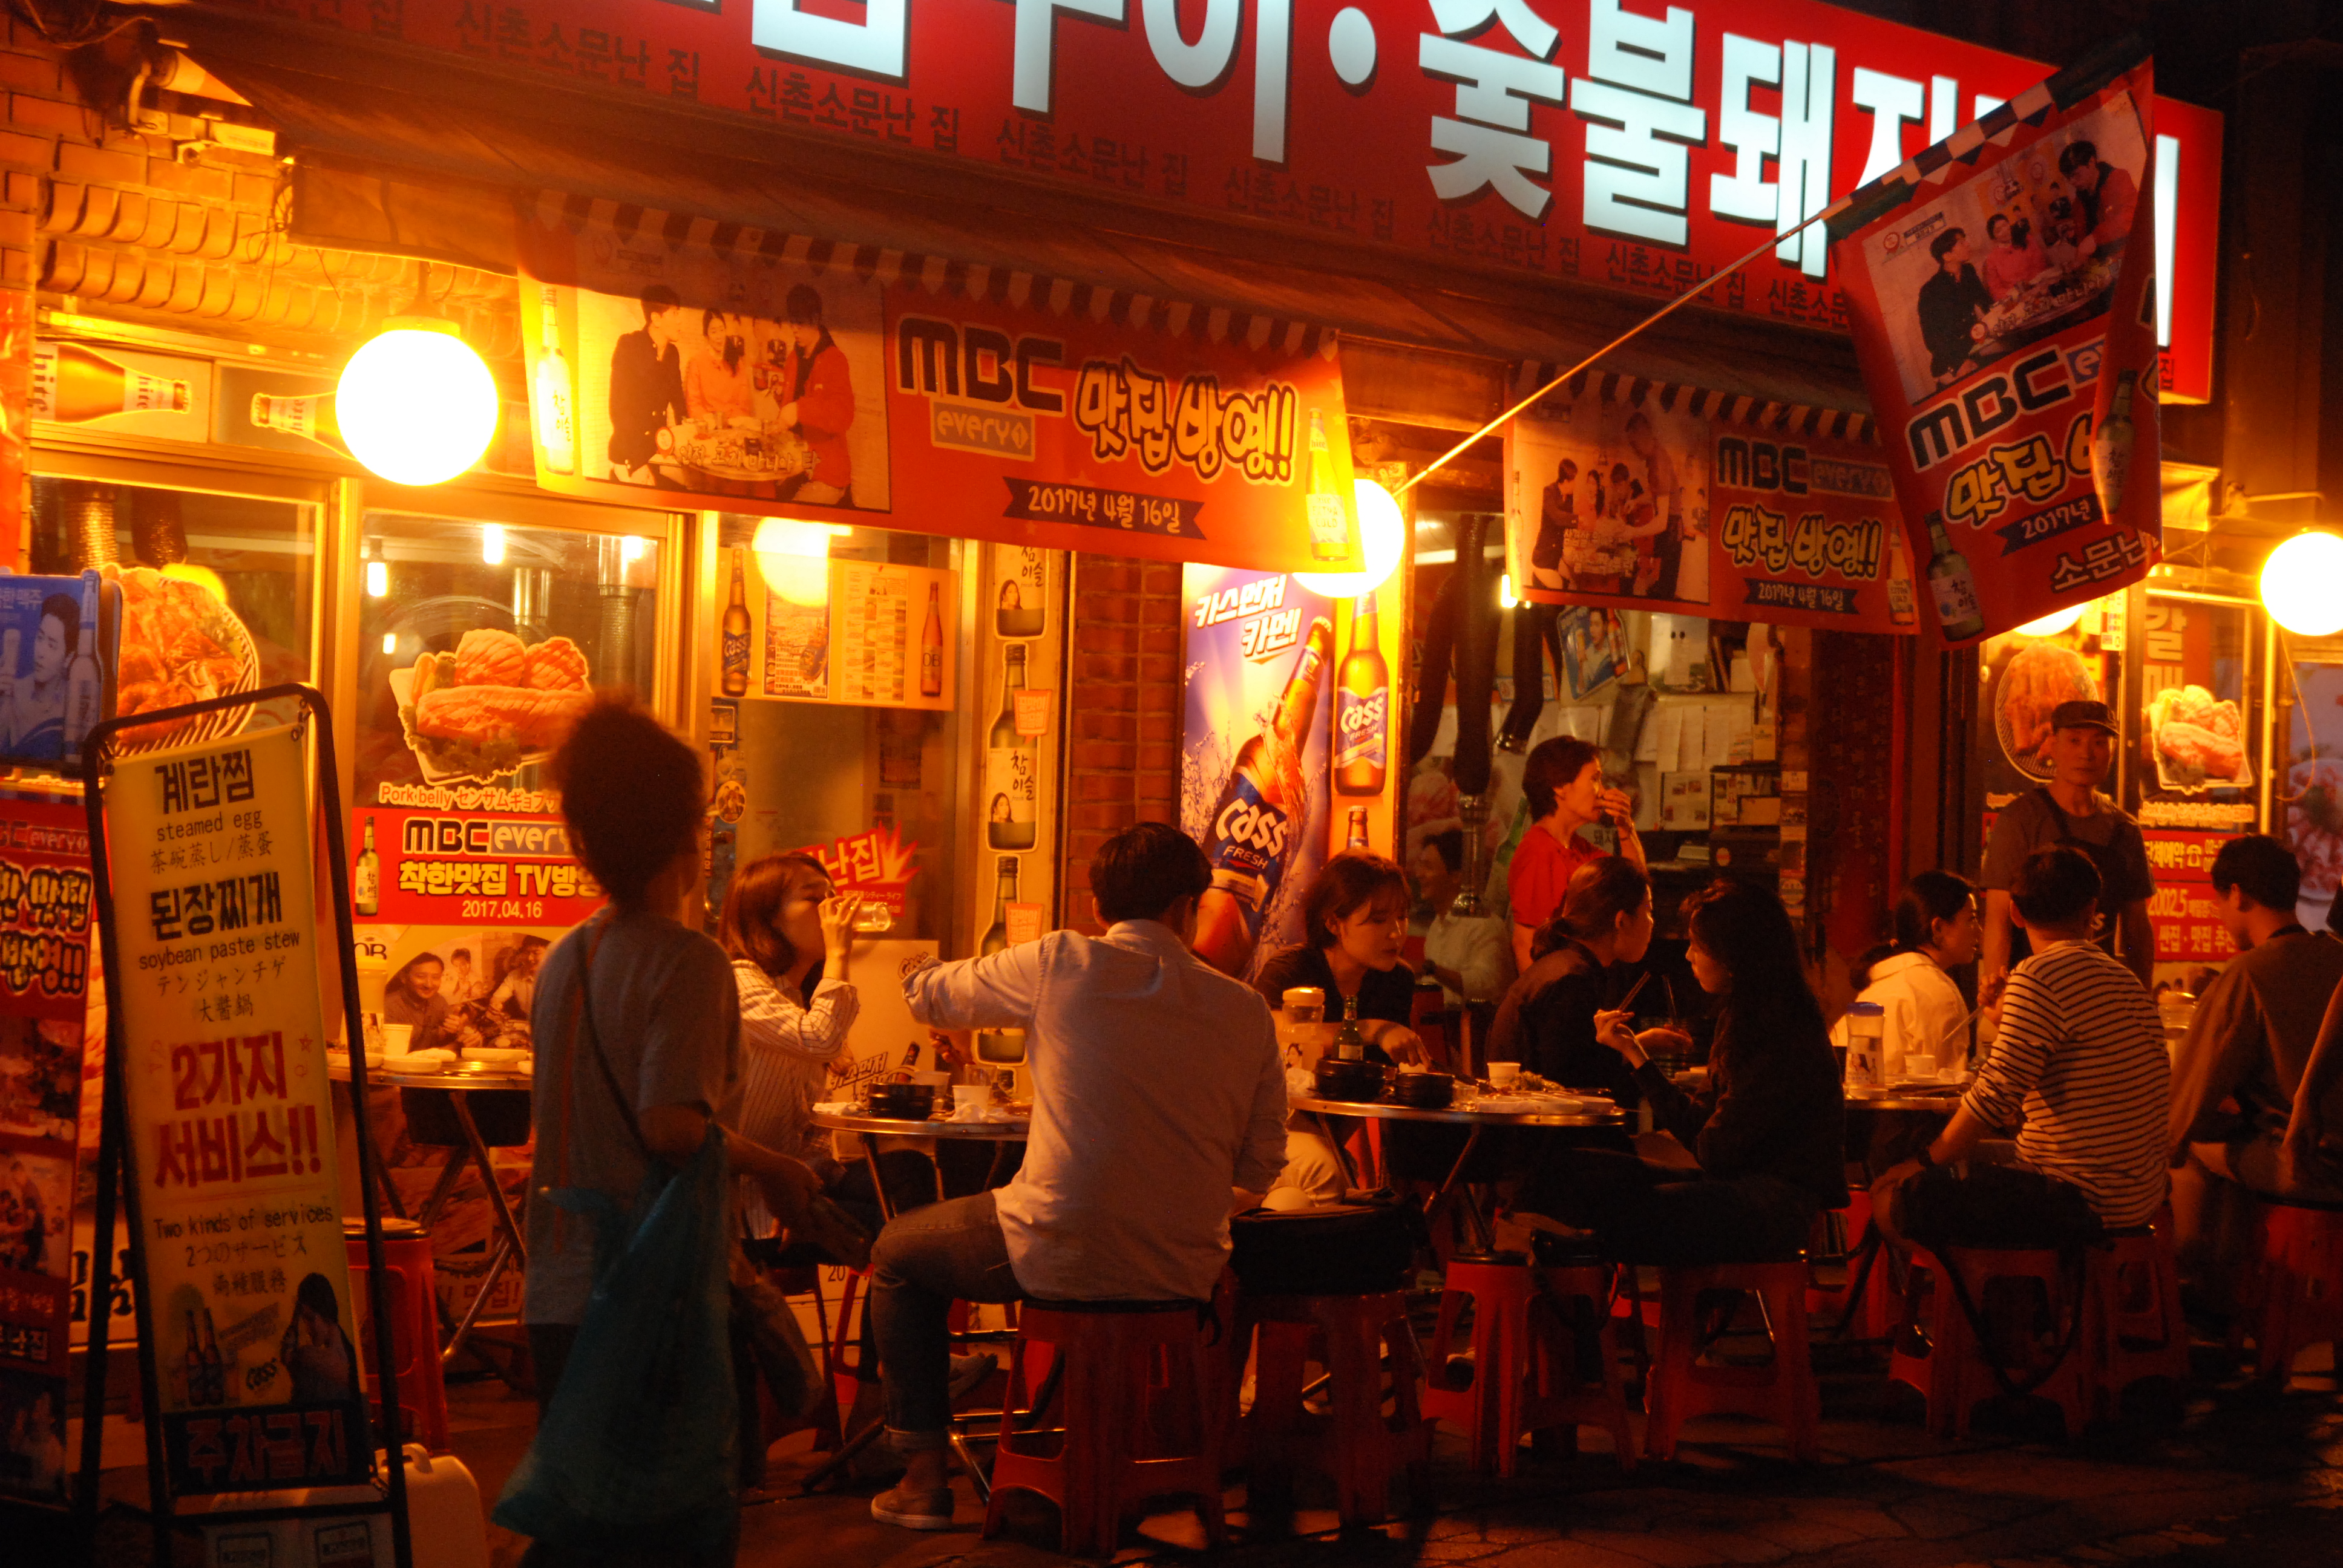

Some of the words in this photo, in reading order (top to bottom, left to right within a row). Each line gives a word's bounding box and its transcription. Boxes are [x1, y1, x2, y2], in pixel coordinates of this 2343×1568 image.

[454, 0, 650, 89] 신촌소문난
[666, 48, 700, 100] 집
[745, 67, 916, 143] 신촌소문난
[931, 106, 958, 152] 집
[997, 119, 1149, 189] 신촌소문난
[1162, 153, 1187, 196] 집
[1225, 166, 1361, 234] 신촌소문난
[1371, 199, 1394, 241] 집
[1426, 208, 1548, 270] 신촌소문난
[1559, 237, 1579, 275] 집
[1726, 270, 1746, 309] 집
[899, 318, 1063, 414] MBC
[137, 376, 151, 410] hite
[1909, 348, 2073, 469] MBC
[1718, 437, 1808, 495] MBC
[1028, 486, 1097, 520] 2017년
[1104, 494, 1135, 528] 4월
[1141, 498, 1181, 534] 16일
[2022, 499, 2090, 538] 2017년
[1194, 575, 1286, 628] 카스먼저
[1758, 583, 1796, 606] 2017년
[1820, 589, 1844, 612] 16일
[1340, 696, 1384, 734] Cass
[1349, 724, 1378, 741] FRESH
[154, 750, 254, 814] 계란찜
[1011, 750, 1028, 775] 참
[381, 785, 414, 803] Pork
[419, 786, 451, 809] belly
[1012, 775, 1034, 801] 이슬
[157, 812, 223, 842] steamed
[234, 810, 263, 831] egg
[405, 820, 488, 853] MBC
[1216, 798, 1287, 858] Cass
[399, 860, 506, 896] 착한맛집
[1222, 844, 1268, 871] FRESH
[150, 872, 283, 942] 된장찌개
[462, 900, 542, 918] 2017.04.16
[139, 946, 203, 971] soybean
[210, 935, 255, 966] paste
[264, 930, 300, 950] stew
[172, 1031, 287, 1111] 2가지
[154, 1105, 322, 1189] 서비스!!
[153, 1218, 183, 1238] Two
[188, 1213, 231, 1236] kinds
[238, 1208, 255, 1232] of
[264, 1203, 333, 1228] services
[187, 1410, 348, 1484] 주차금지
